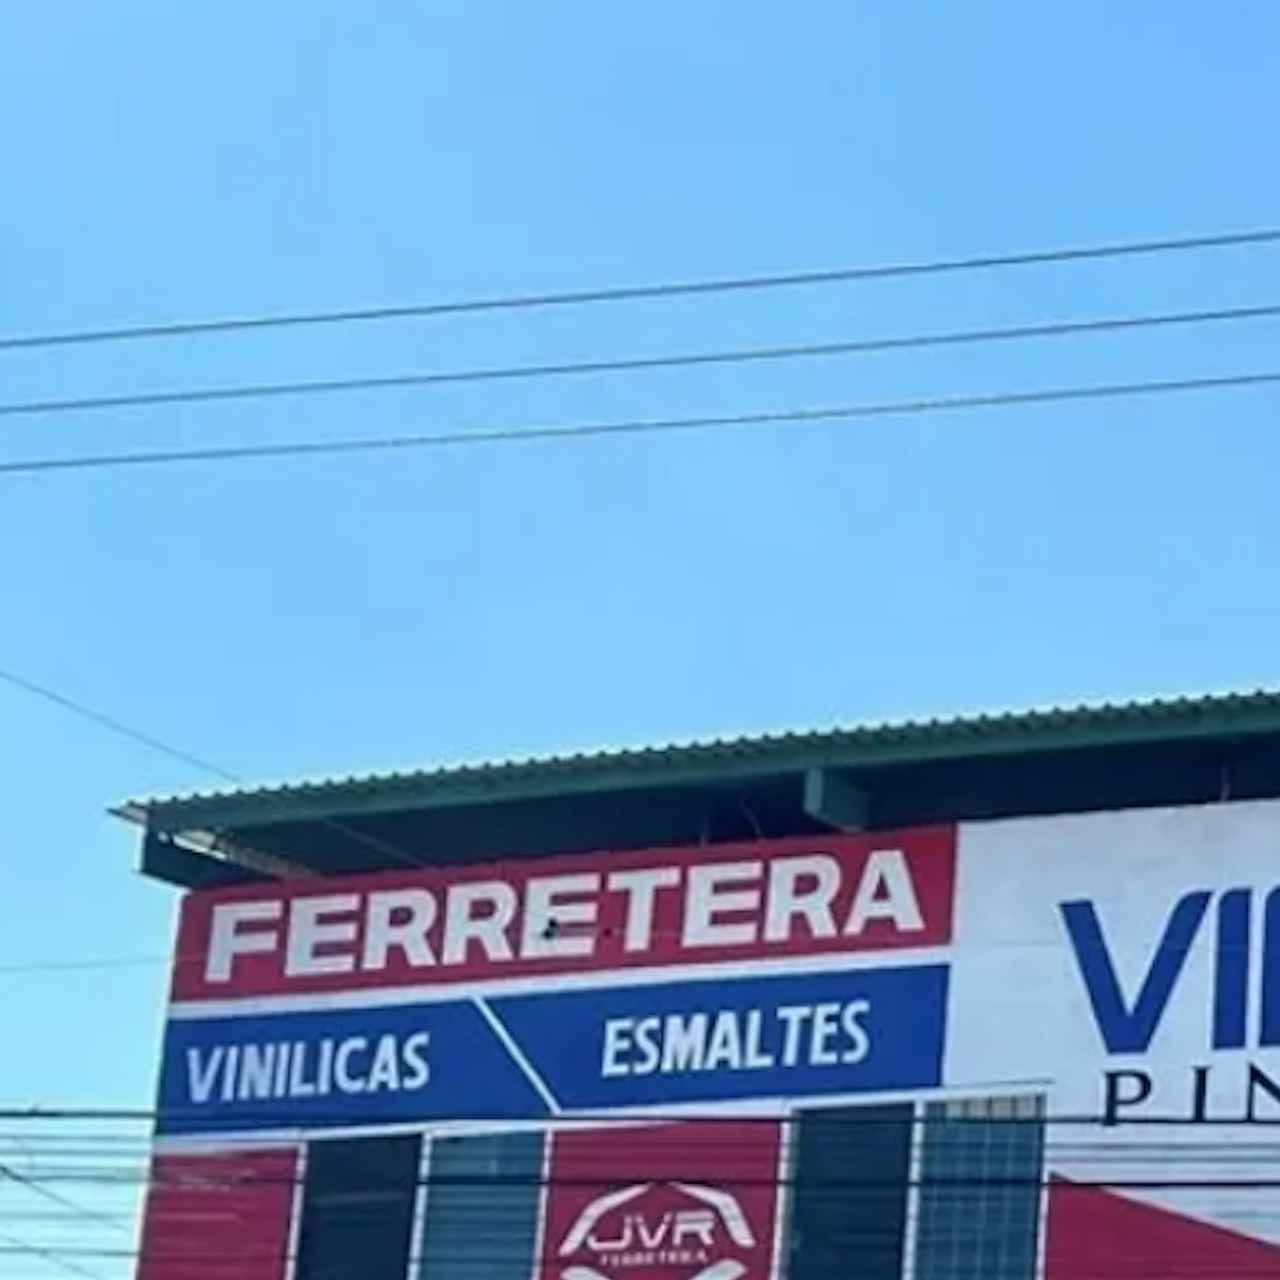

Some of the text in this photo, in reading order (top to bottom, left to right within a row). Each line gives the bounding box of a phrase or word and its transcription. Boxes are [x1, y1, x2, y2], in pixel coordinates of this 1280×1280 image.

[205, 849, 924, 983] FERRETERA
[186, 1033, 430, 1103] VINILICAS
[602, 1000, 871, 1078] ESMALTES
[586, 1210, 714, 1249] JVR
